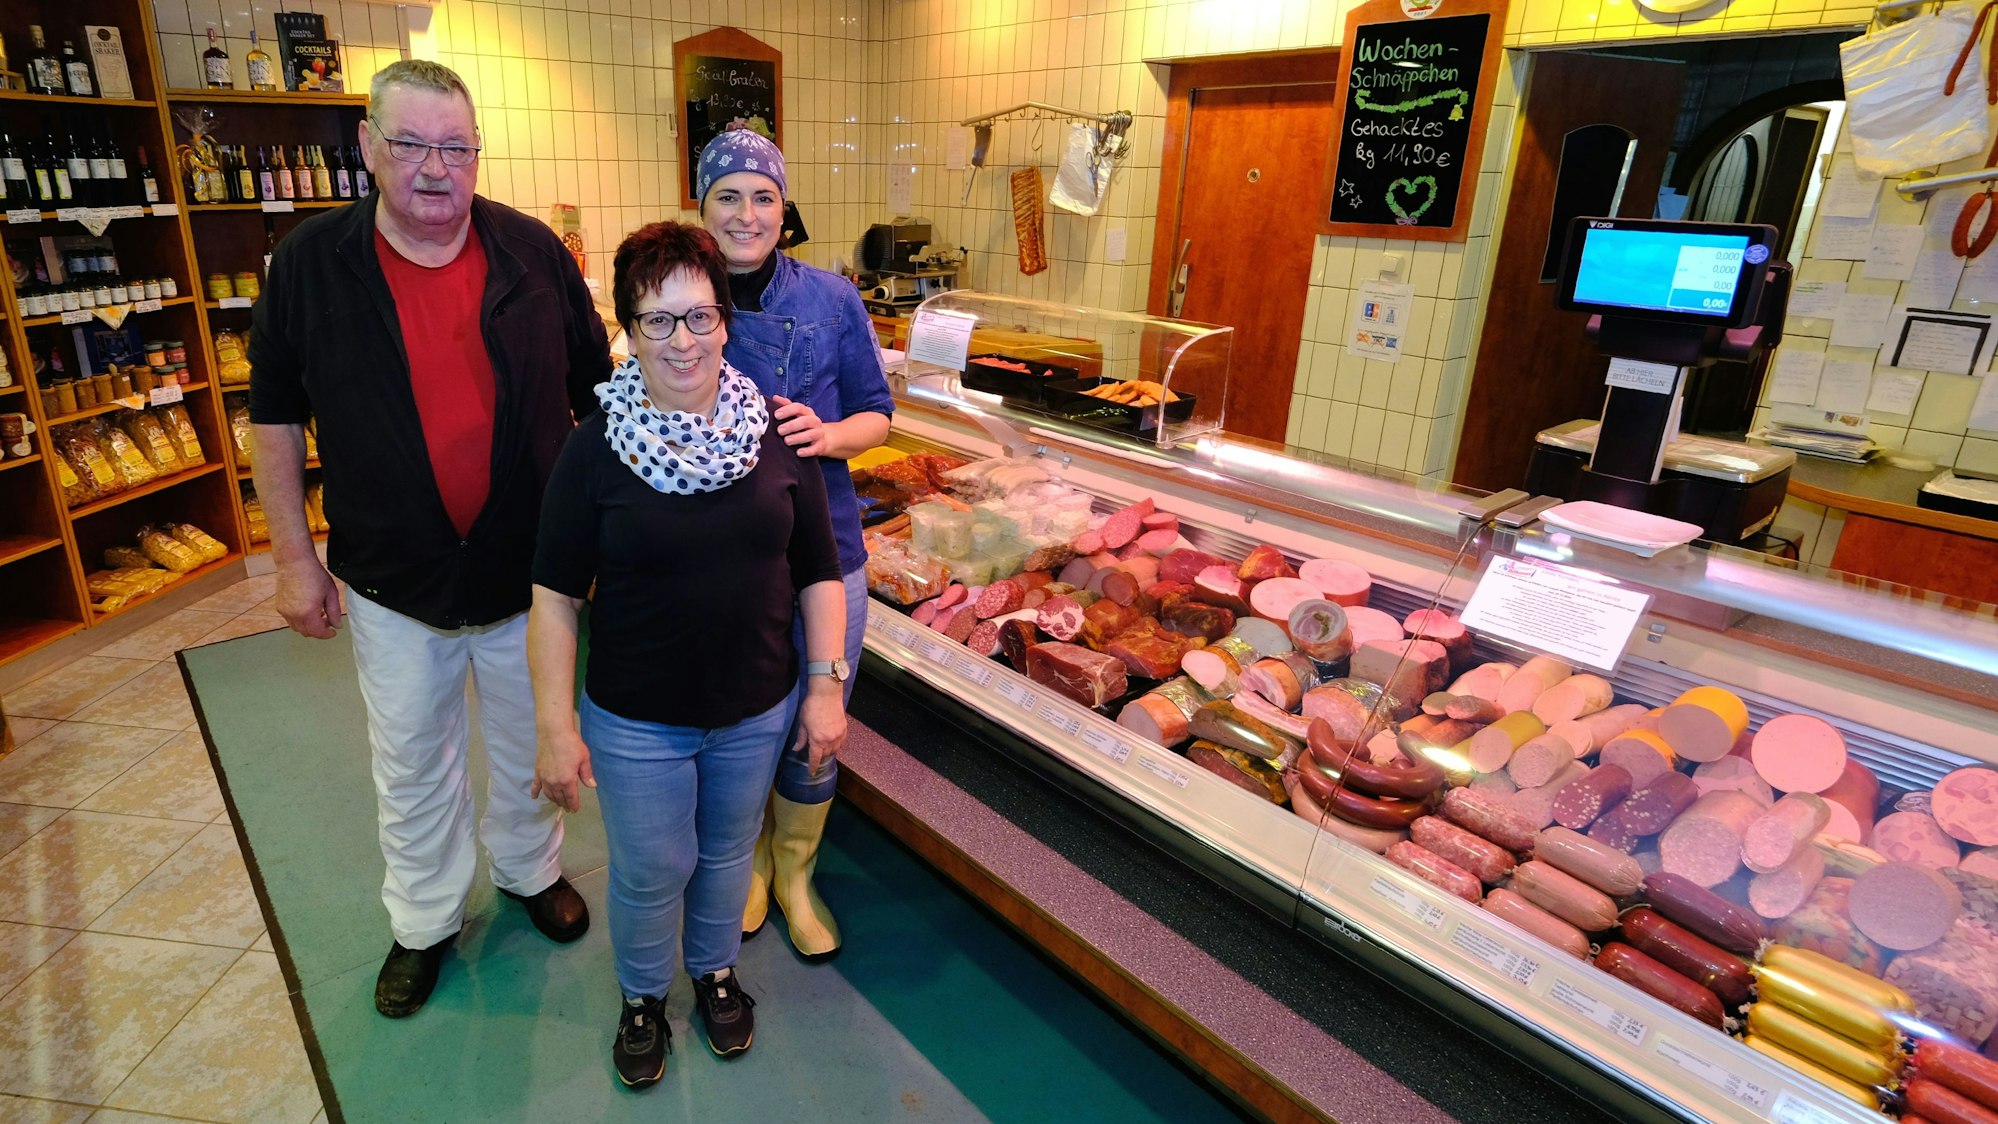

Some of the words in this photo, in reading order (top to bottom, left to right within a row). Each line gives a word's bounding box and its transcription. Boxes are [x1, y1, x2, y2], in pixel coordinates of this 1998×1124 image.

[294, 45, 332, 54] COCKTAILS
[1350, 63, 1459, 92] Schnäppchen
[1351, 117, 1444, 137] Gehacktes
[1356, 142, 1375, 169] kg
[1715, 251, 1740, 261] 0,000
[1712, 265, 1737, 275] 0,000
[1714, 281, 1732, 291] 0,00
[1612, 373, 1630, 382] BITTE
